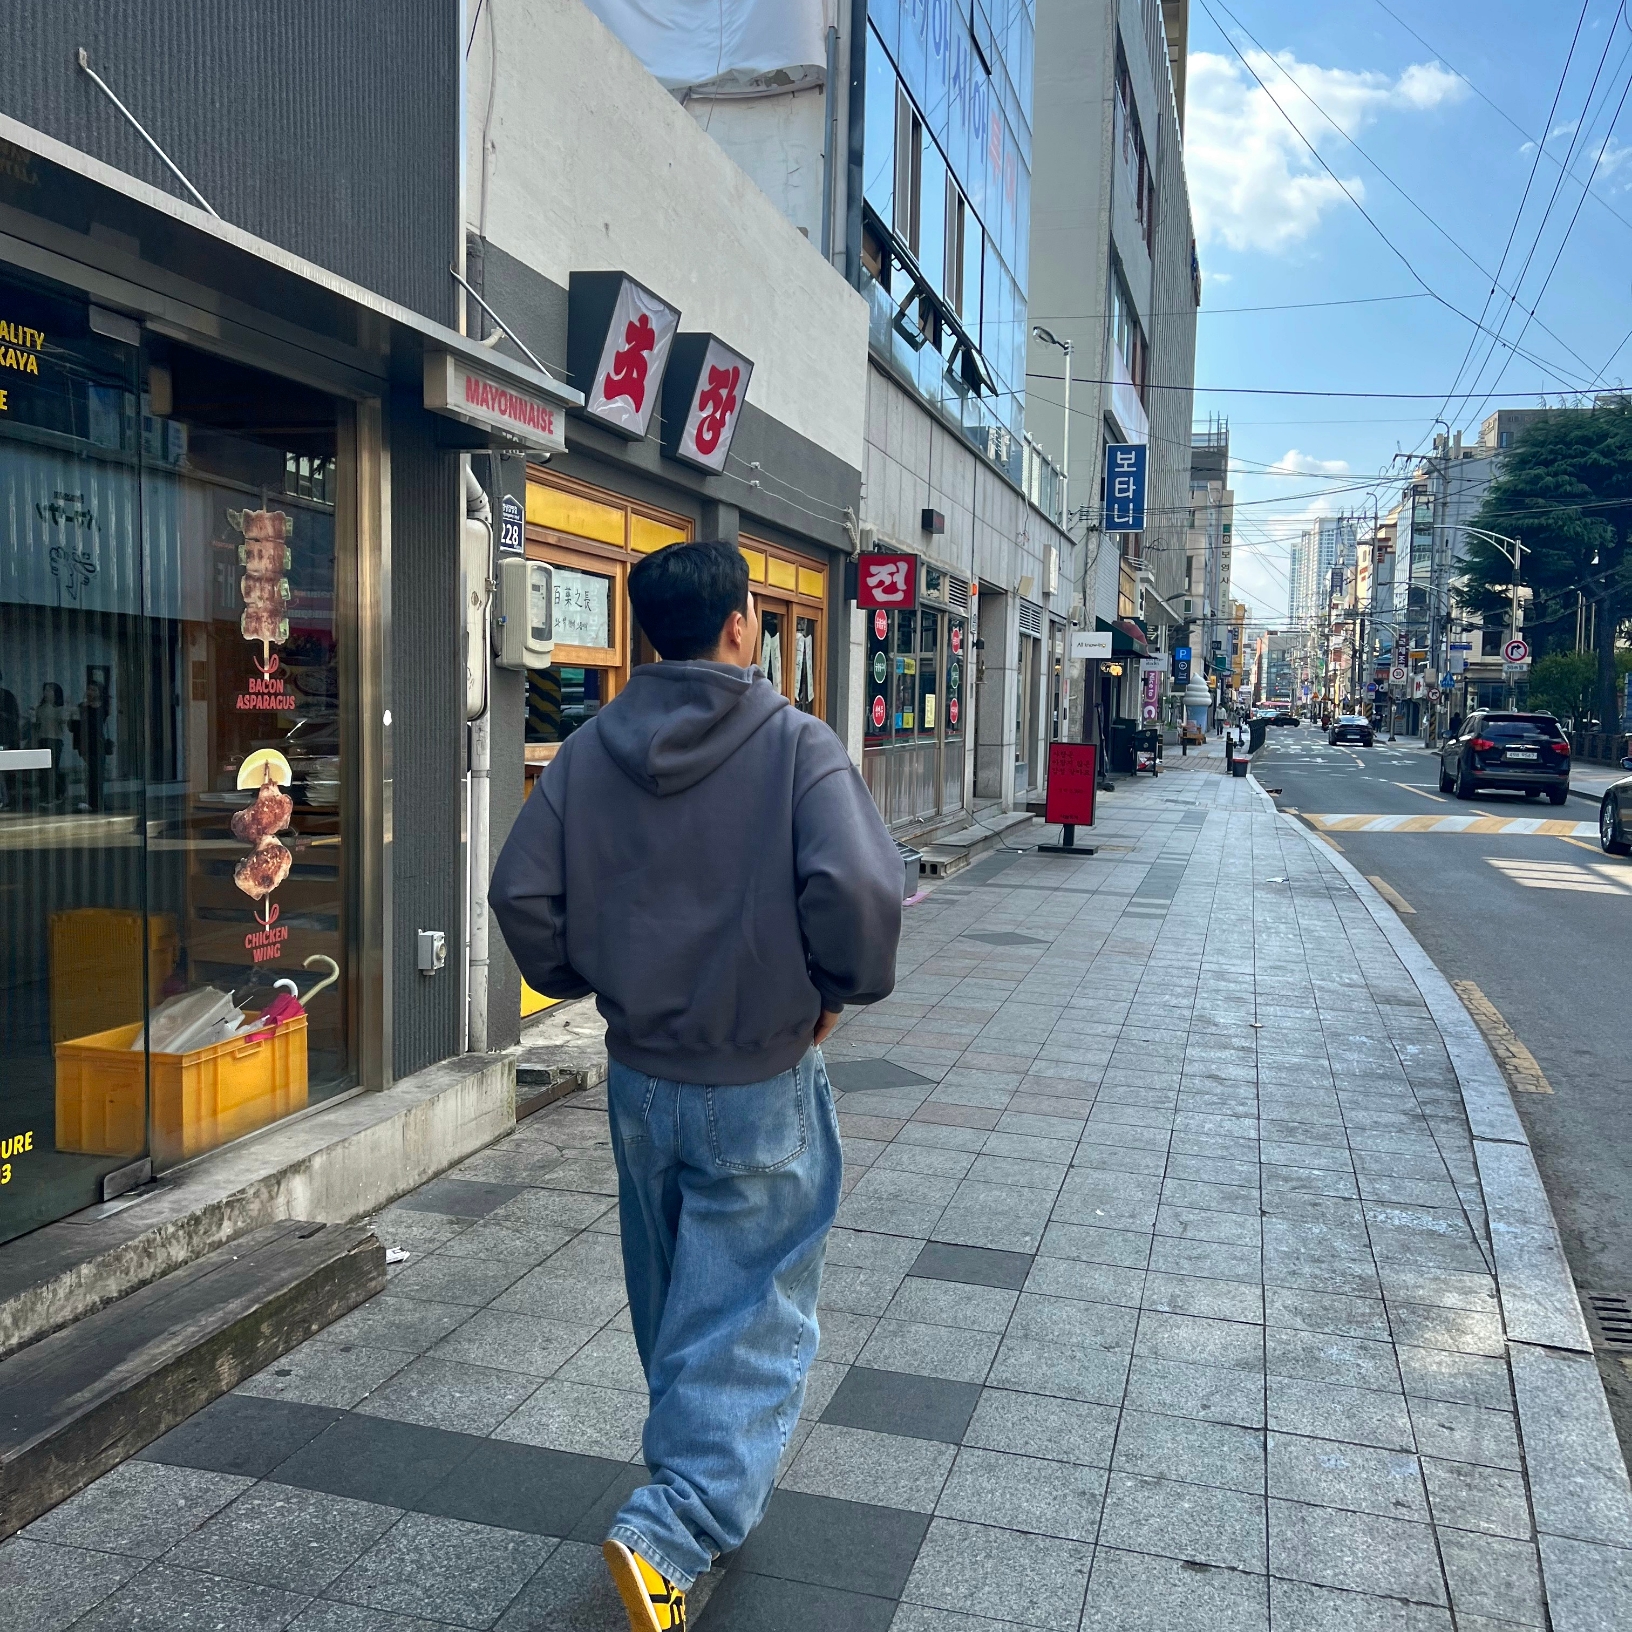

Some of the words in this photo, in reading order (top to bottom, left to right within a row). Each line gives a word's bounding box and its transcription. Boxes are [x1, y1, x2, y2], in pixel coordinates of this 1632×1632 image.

[465, 375, 554, 435] MAYONNAISE
[1114, 450, 1137, 525] 보타니
[866, 561, 908, 602] 전
[1179, 649, 1187, 659] P
[248, 678, 284, 693] BACON
[236, 694, 296, 709] ASPARAGUS
[244, 926, 288, 949] CHICKEN
[253, 943, 281, 963] WING
[1, 1131, 33, 1159] URE
[1, 1163, 12, 1184] 3
